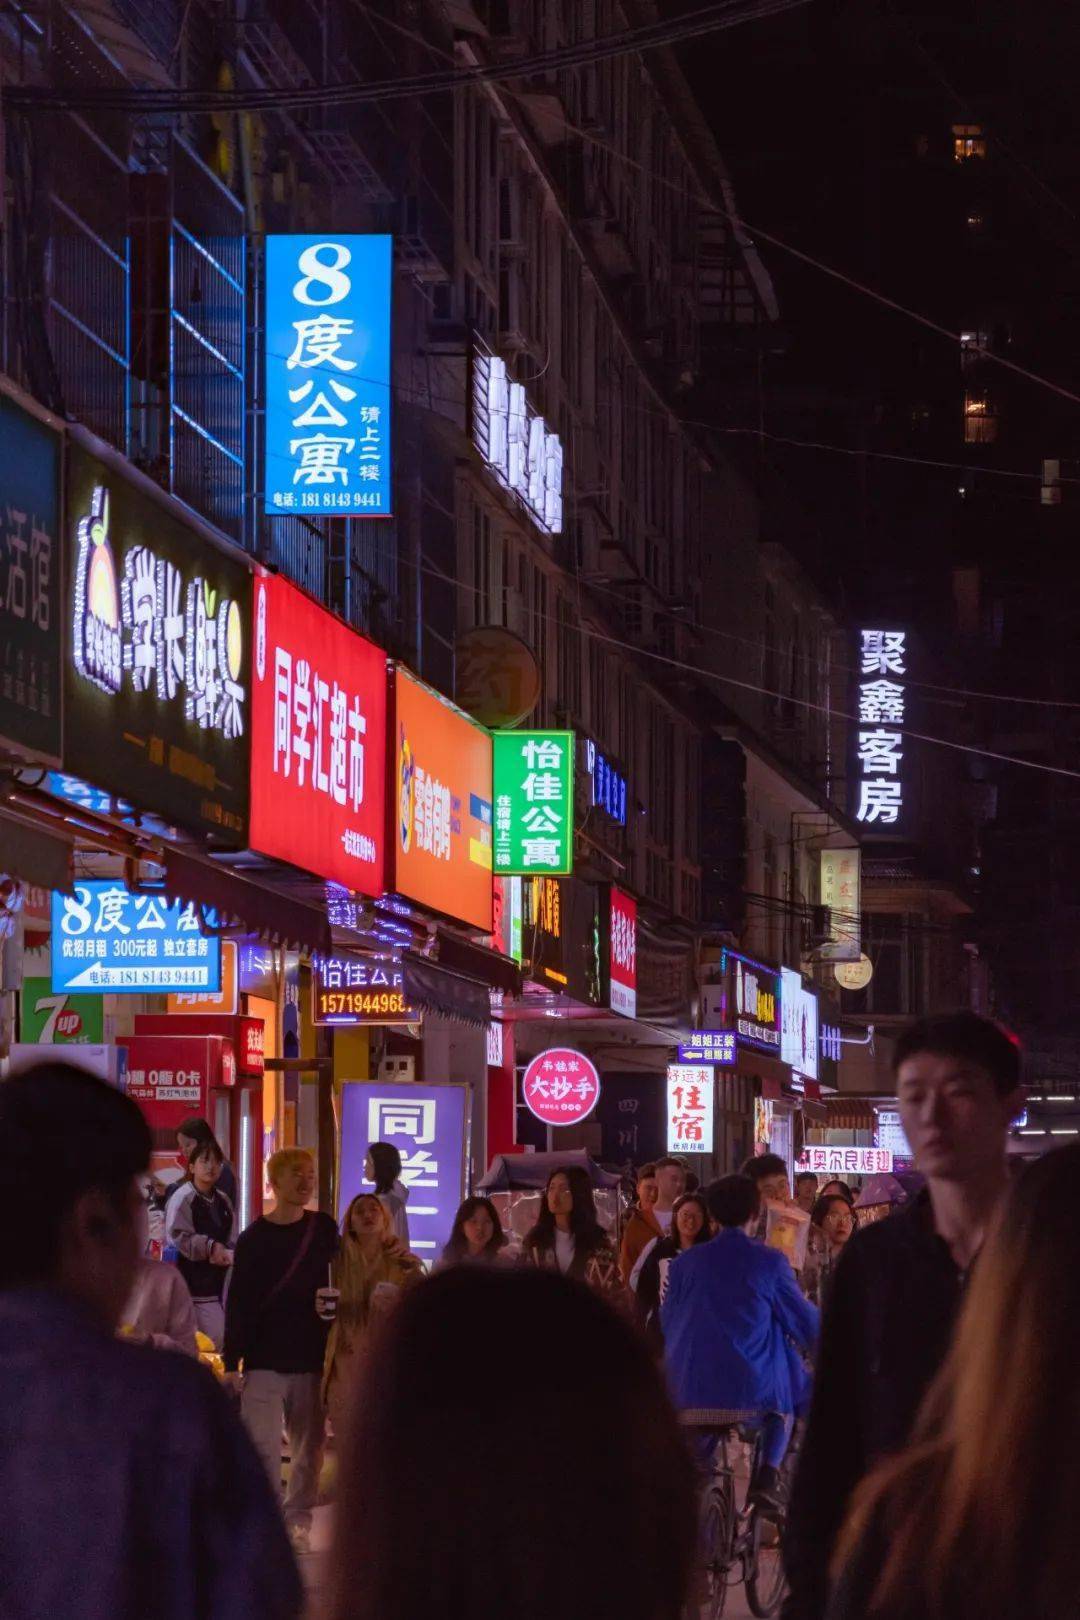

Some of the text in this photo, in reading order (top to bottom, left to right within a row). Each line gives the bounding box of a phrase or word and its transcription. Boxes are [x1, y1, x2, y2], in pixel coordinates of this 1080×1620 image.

[286, 243, 357, 487] 8度公寓
[359, 406, 381, 482] 请上二楼
[301, 492, 321, 507] 181
[323, 492, 351, 507] 8143
[353, 492, 381, 507] 9441
[273, 646, 368, 813] 同学汇超市
[856, 629, 906, 824] 聚鑫客房
[520, 739, 564, 867] 怡佳公寓
[62, 938, 208, 959] 优招月租 300元起 独立套房
[119, 969, 138, 984] 181
[141, 969, 171, 984] 8143
[174, 969, 203, 984] 9441
[320, 994, 412, 1014] 1571944968
[530, 1075, 595, 1101] 大抄手
[666, 1069, 709, 1083] 好运来
[671, 1085, 706, 1141] 住宿
